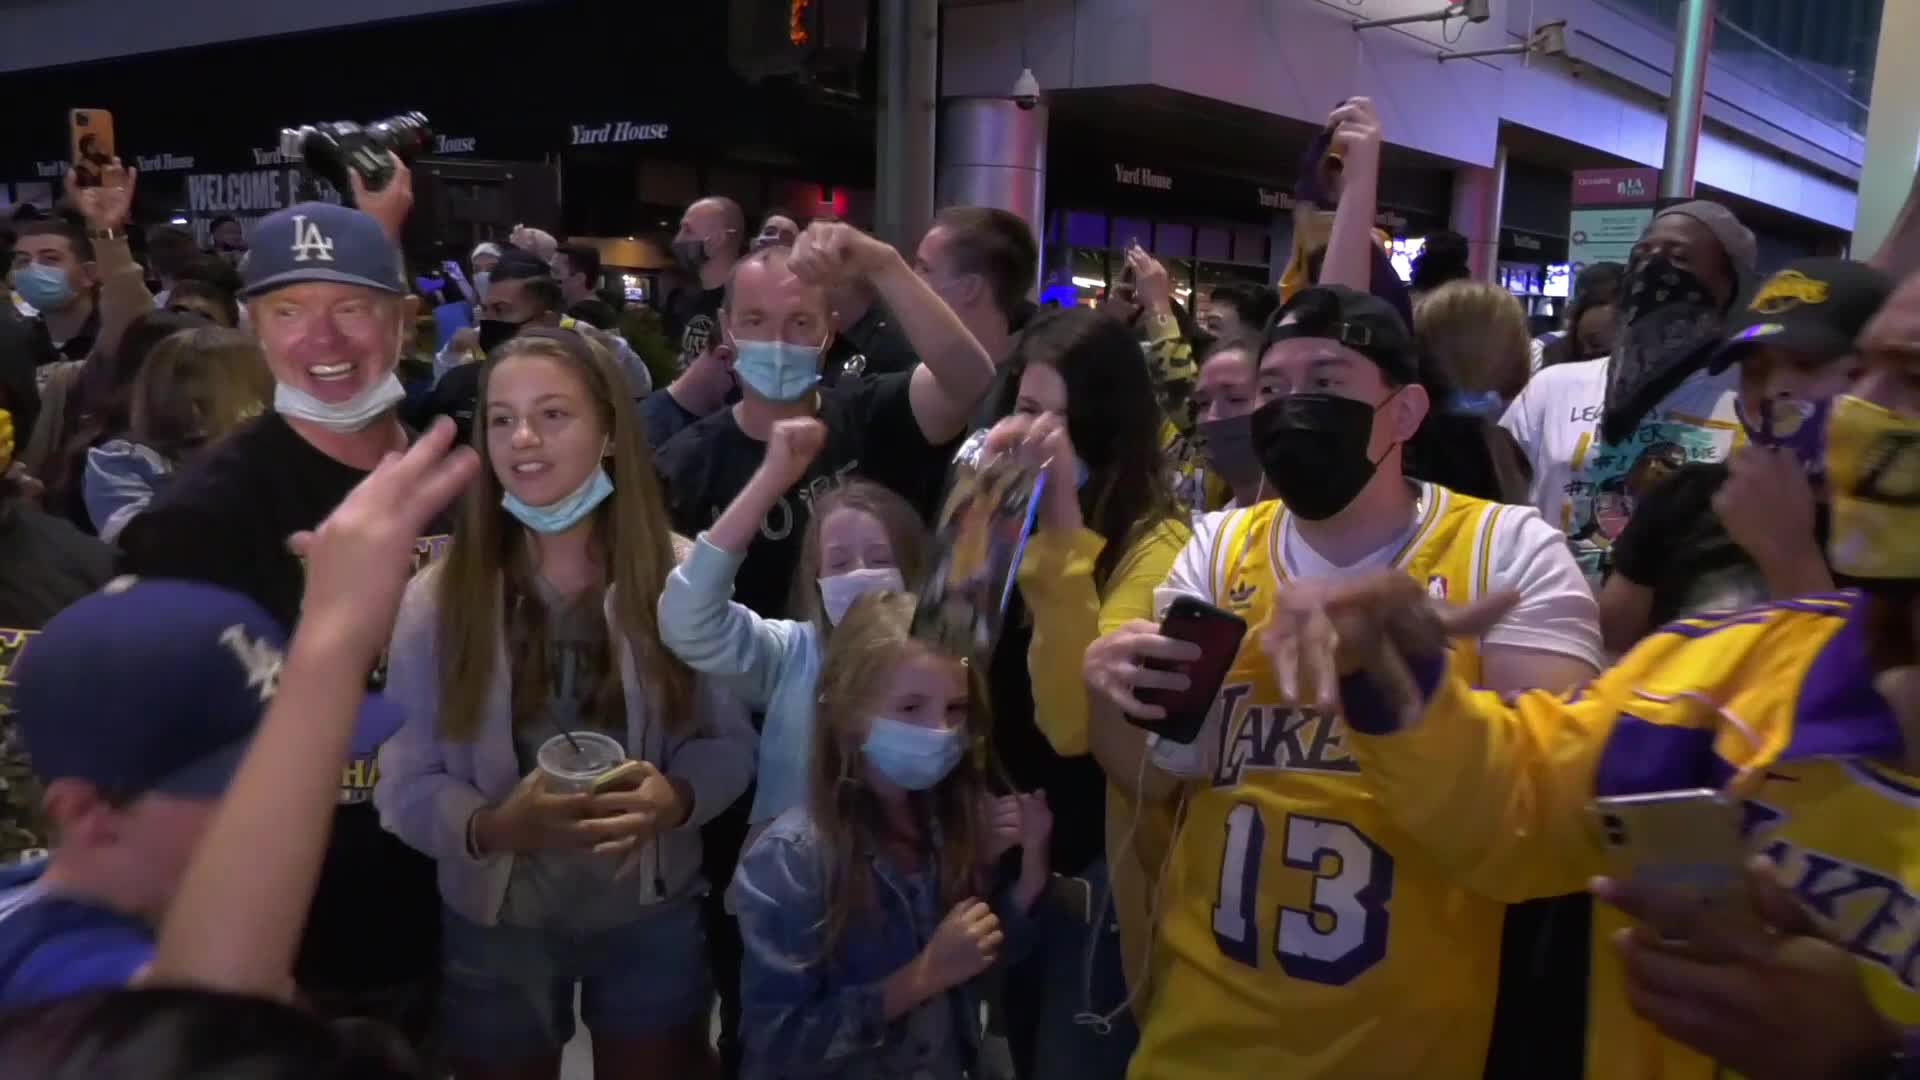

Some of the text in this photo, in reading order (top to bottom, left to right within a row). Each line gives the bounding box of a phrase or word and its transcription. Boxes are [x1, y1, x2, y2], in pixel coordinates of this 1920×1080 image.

[571, 121, 669, 145] Yard House
[188, 170, 282, 211] WELCOME
[1114, 164, 1172, 190] Yard House
[291, 215, 334, 261] LA
[1211, 682, 1361, 790] LAKE
[1211, 801, 1394, 986] 13
